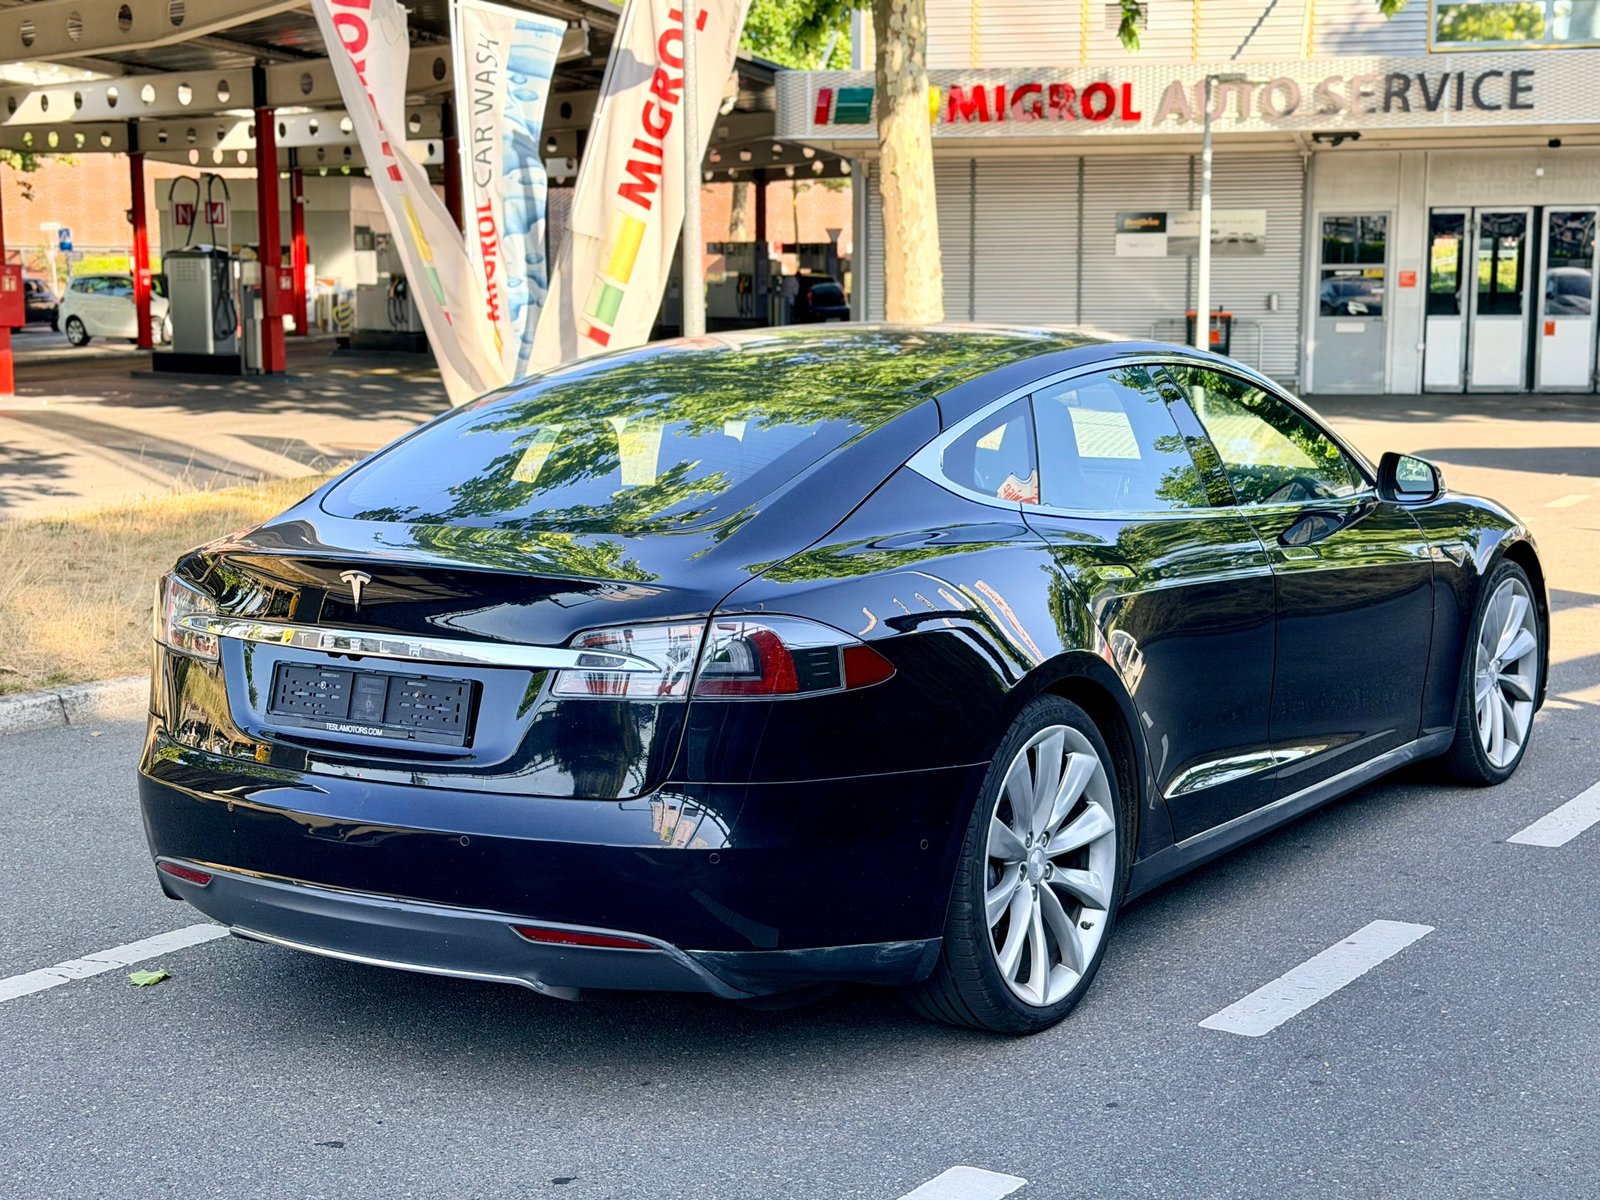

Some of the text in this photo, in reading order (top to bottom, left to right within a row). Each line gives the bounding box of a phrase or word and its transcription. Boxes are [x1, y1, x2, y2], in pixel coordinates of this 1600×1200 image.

[474, 32, 499, 116] WASH
[945, 69, 1535, 124] MIGROL AUTO SERVICE
[617, 8, 708, 211] MIGROL
[474, 125, 494, 188] CAR
[325, 722, 383, 736] TESLAMOTORS.COM
